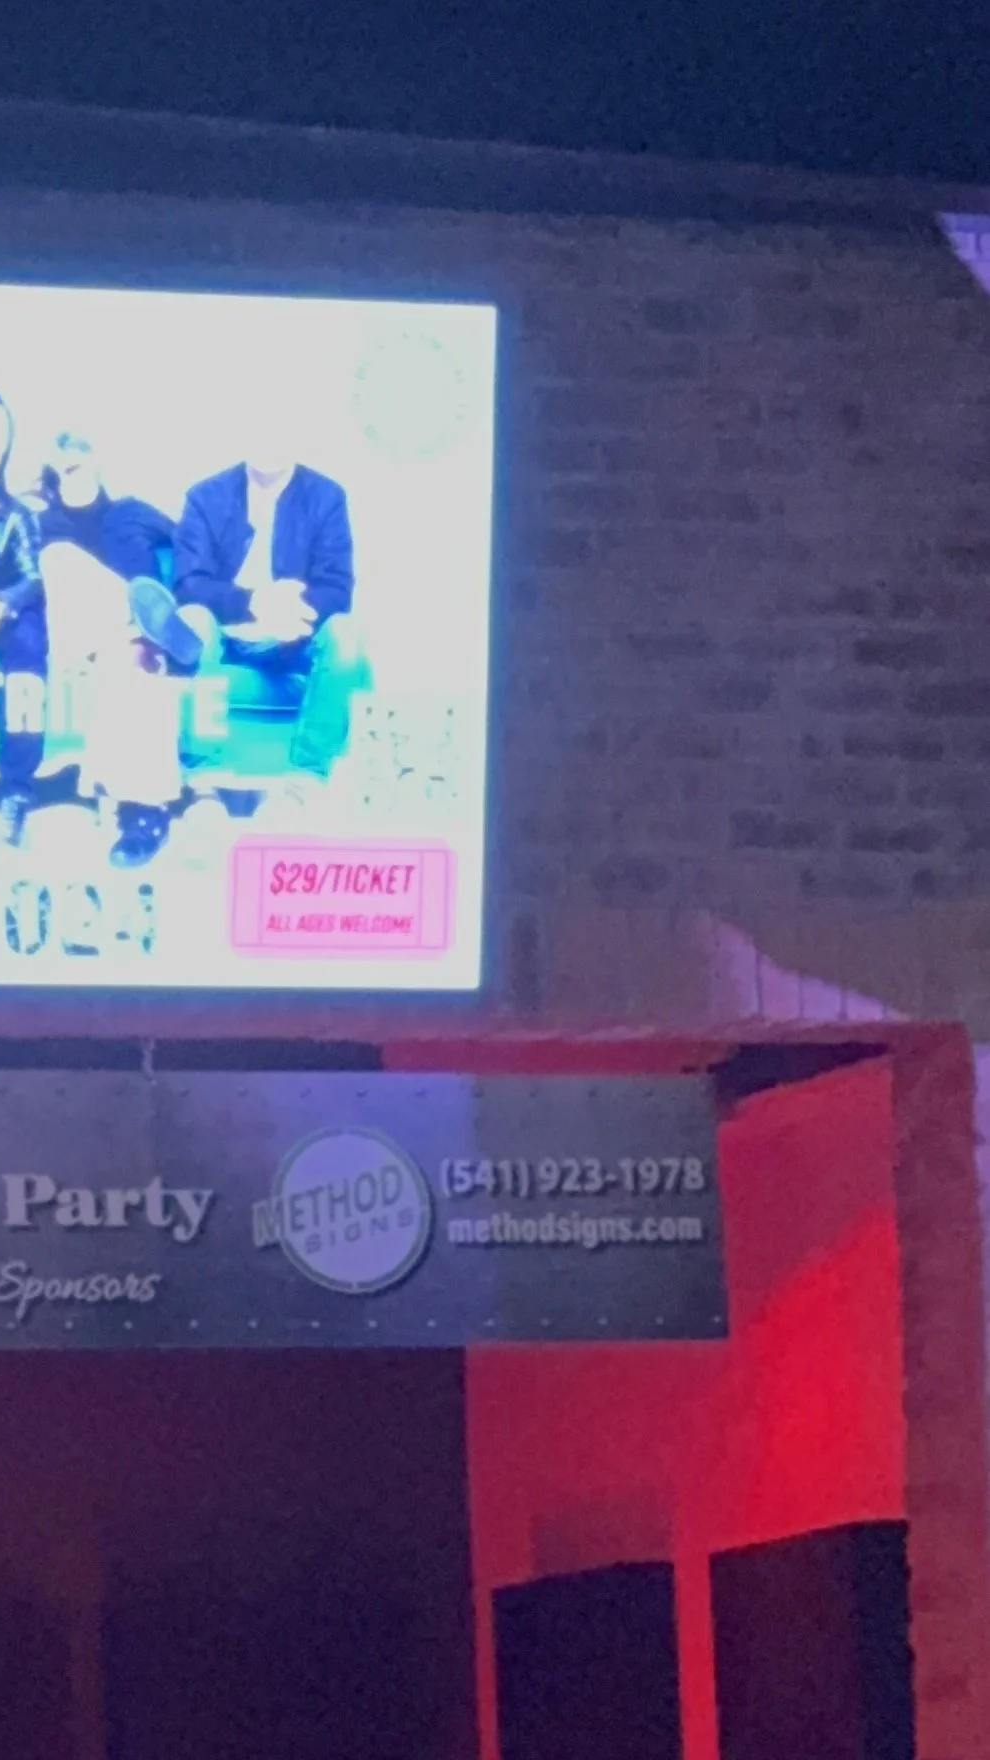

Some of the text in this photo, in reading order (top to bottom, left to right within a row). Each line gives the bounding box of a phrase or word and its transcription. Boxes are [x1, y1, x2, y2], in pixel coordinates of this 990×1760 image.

[269, 860, 415, 896] $29/TICKET
[266, 913, 292, 932] ALL
[339, 915, 414, 935] WELCOME
[439, 1157, 706, 1198] (541) 923-1978
[0, 1173, 214, 1243] Party
[252, 1163, 404, 1248] METHOD
[304, 1206, 415, 1256] SIGNS
[447, 1211, 703, 1250] methodsigns.com
